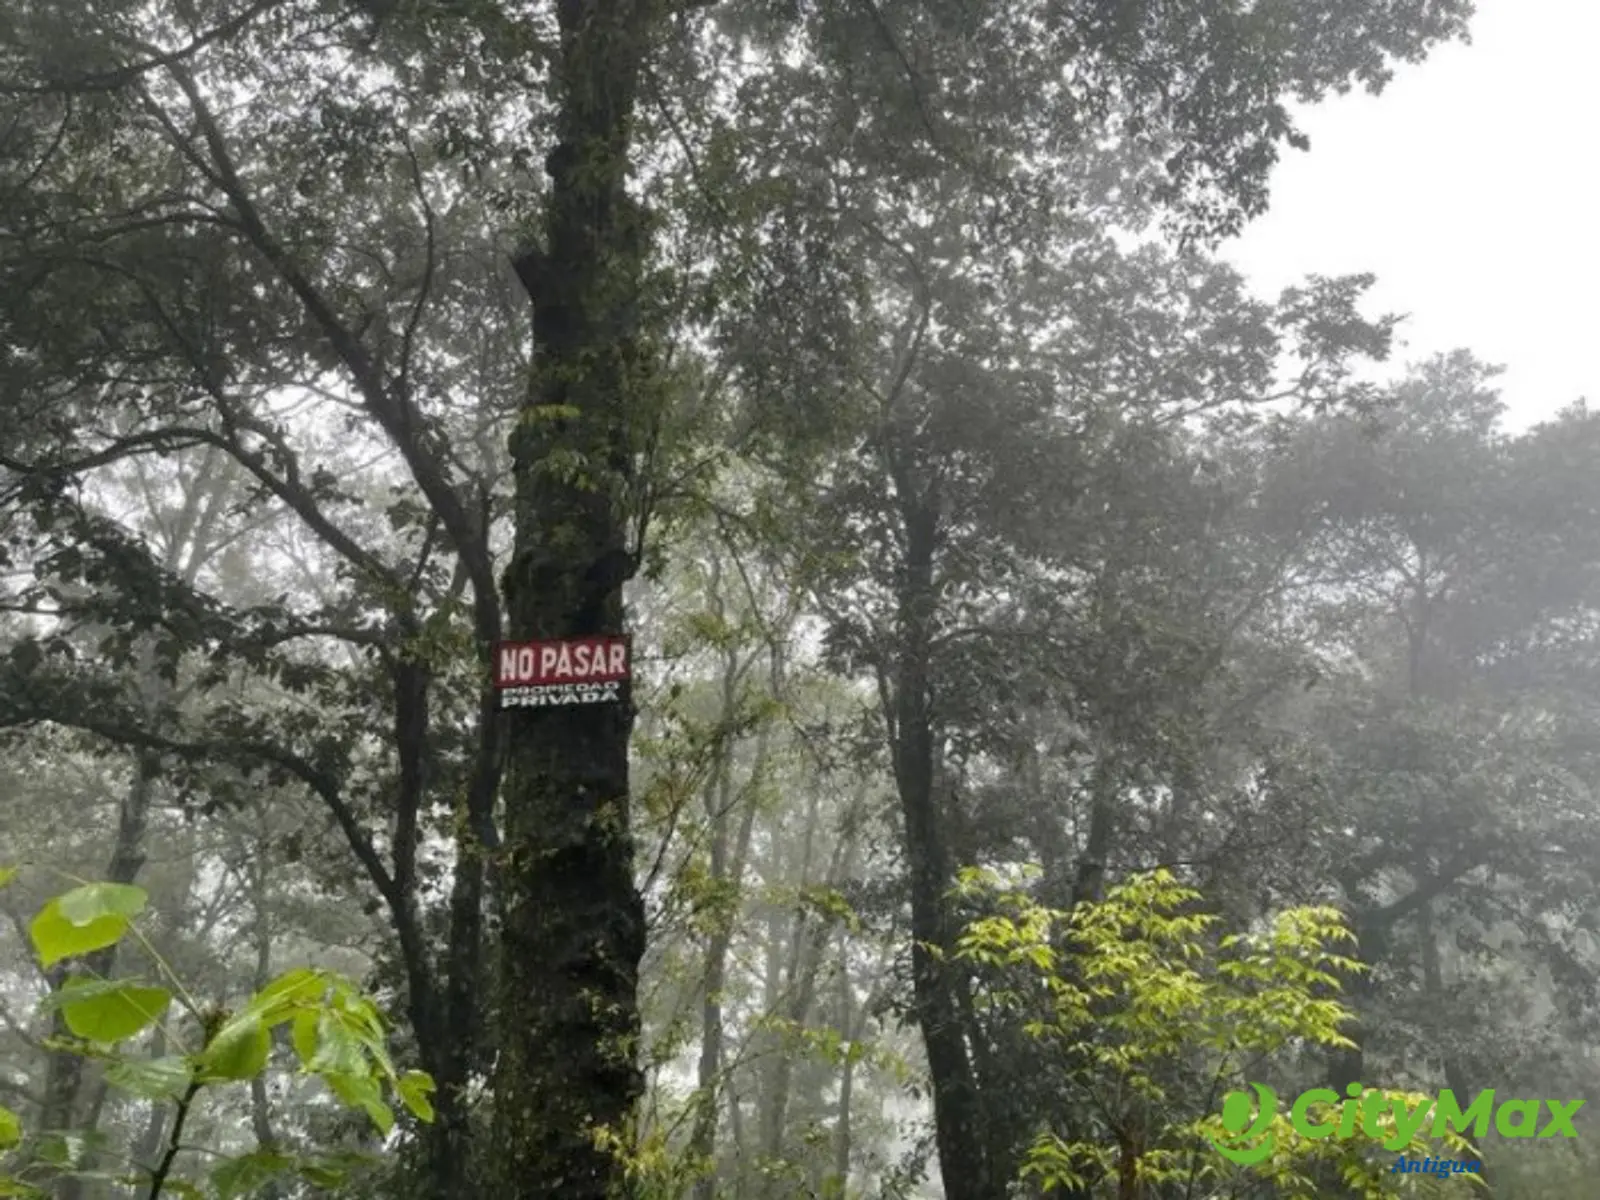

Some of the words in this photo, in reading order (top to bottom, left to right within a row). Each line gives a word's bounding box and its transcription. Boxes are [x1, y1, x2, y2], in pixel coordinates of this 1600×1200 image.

[500, 647, 534, 681] NO
[540, 643, 625, 678] PASAR
[501, 691, 619, 708] PRIVADA
